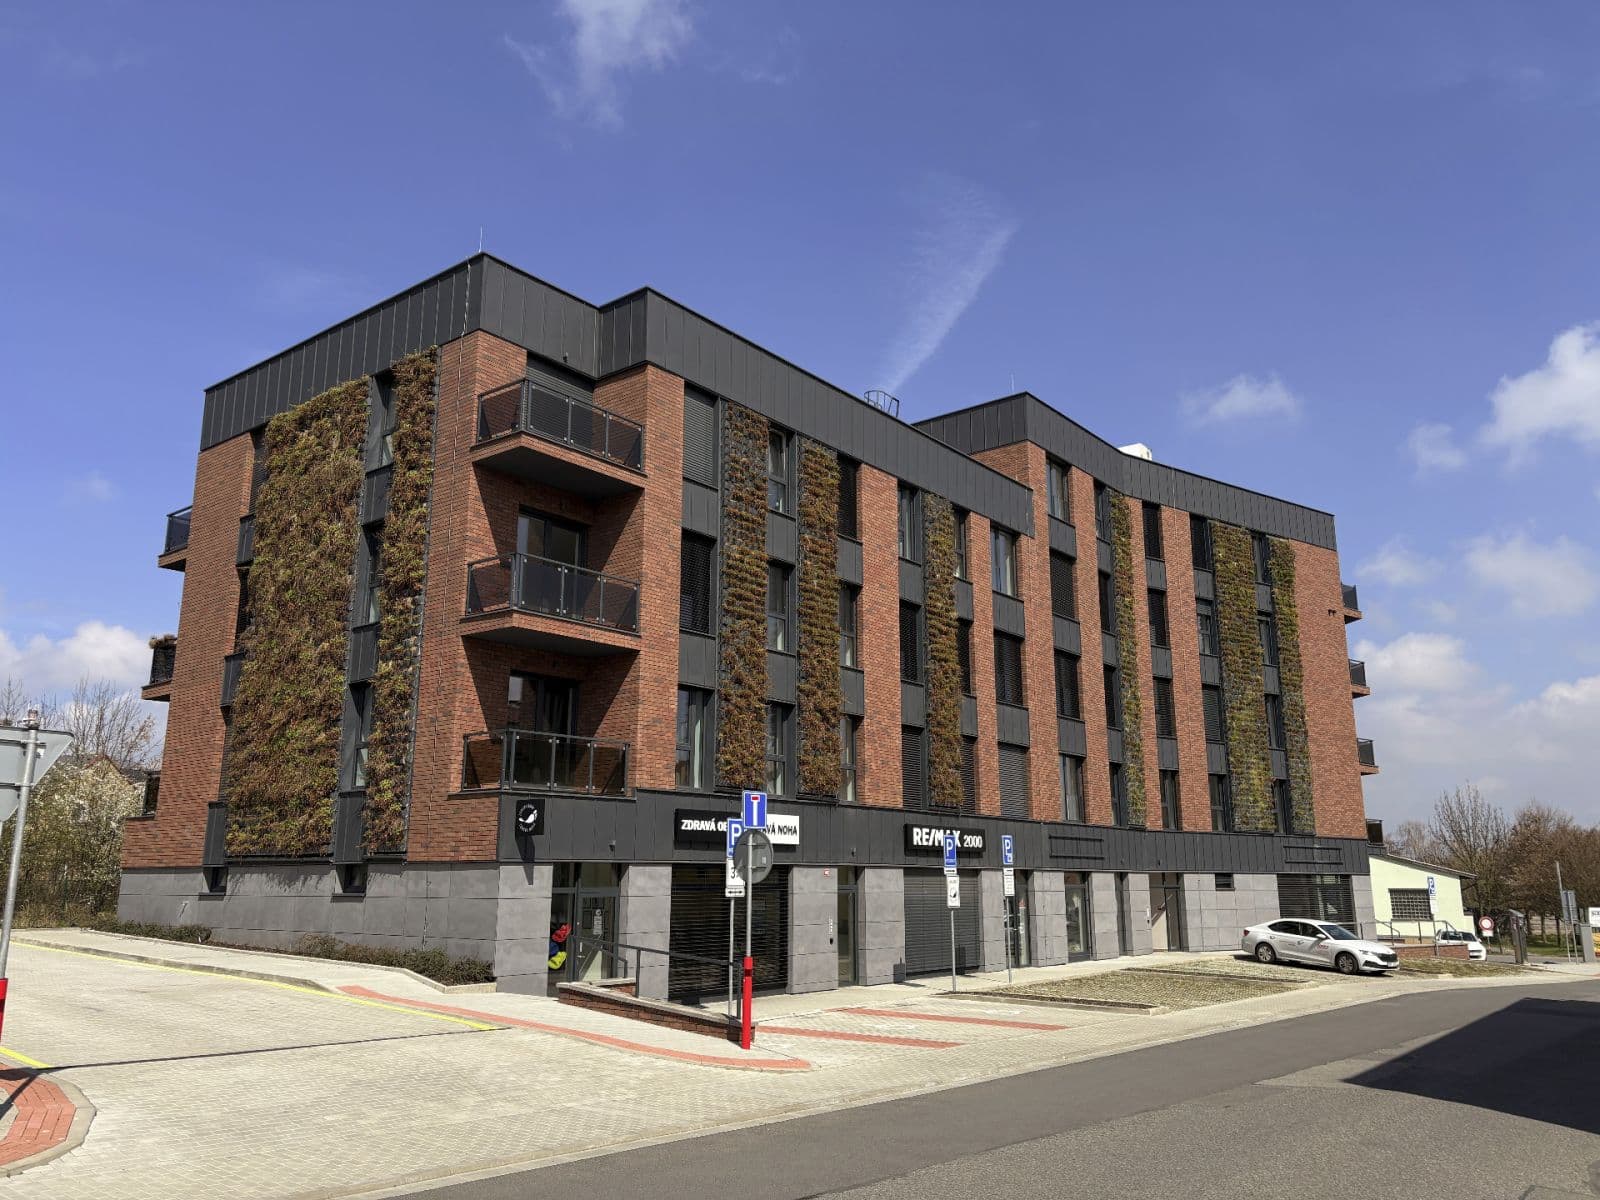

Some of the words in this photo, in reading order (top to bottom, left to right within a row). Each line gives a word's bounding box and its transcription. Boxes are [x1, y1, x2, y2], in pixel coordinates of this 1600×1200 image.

[681, 818, 716, 831] ZDRAVÁ
[777, 824, 798, 836] NOHA
[731, 823, 742, 846] P
[963, 834, 983, 848] 2000
[946, 839, 954, 857] P
